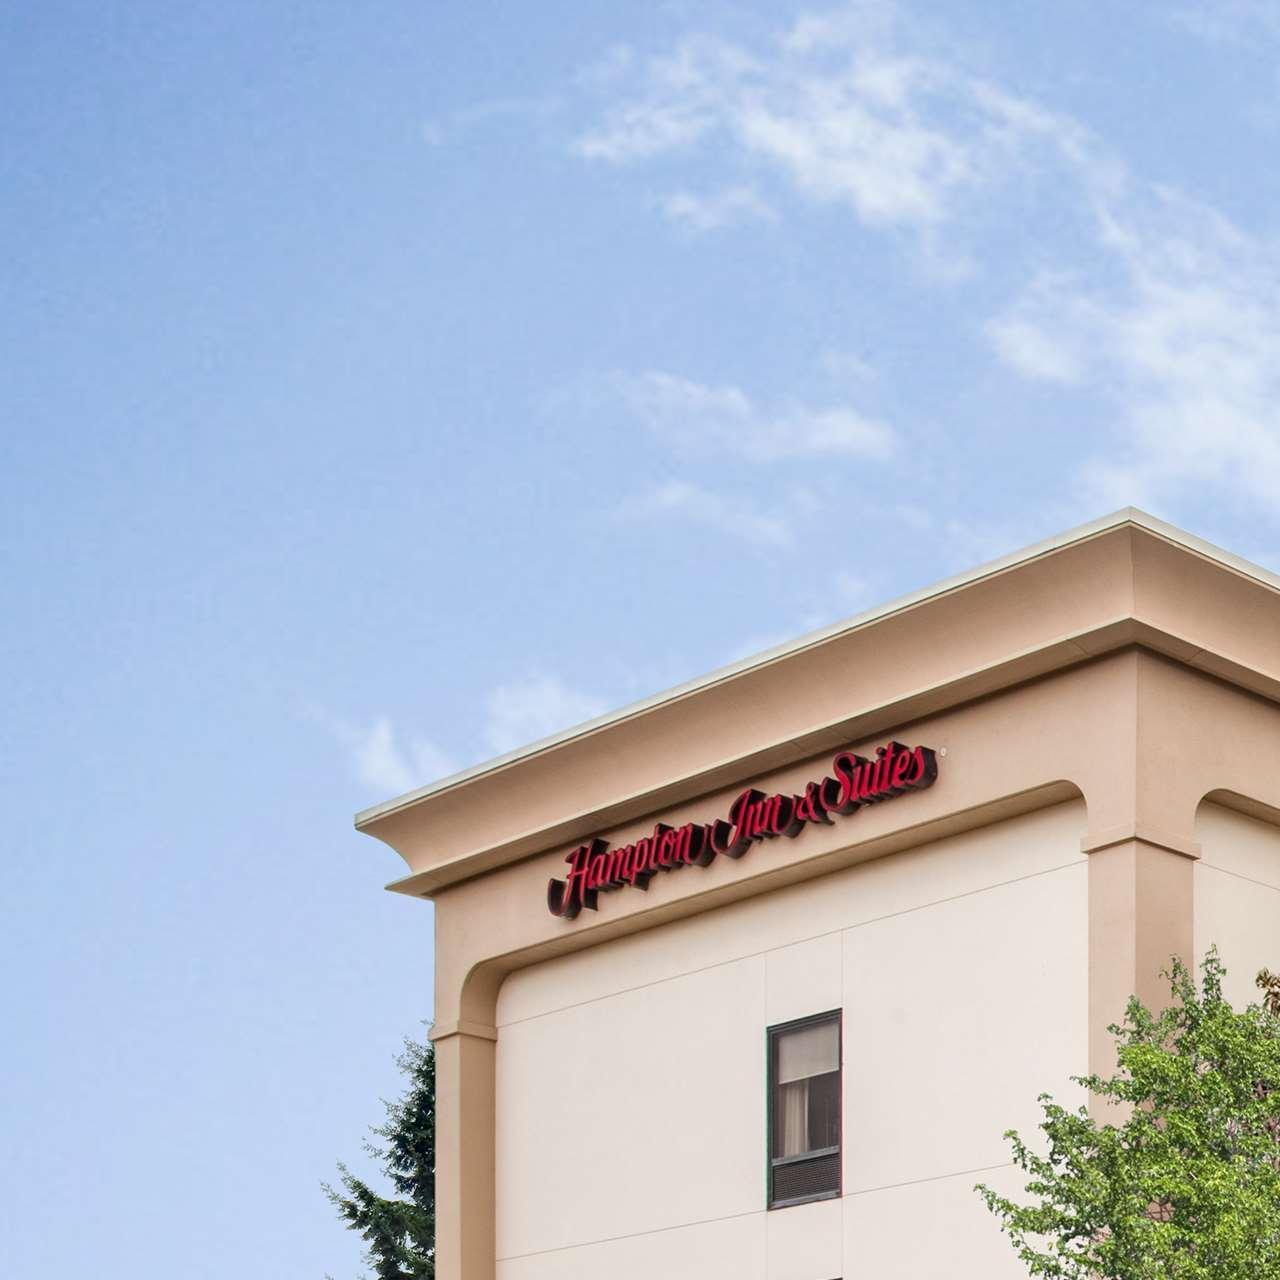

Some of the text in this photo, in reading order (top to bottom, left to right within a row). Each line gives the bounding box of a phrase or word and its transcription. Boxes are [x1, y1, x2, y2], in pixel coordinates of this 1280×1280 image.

[548, 741, 938, 920] Hampton Inn & Suites
